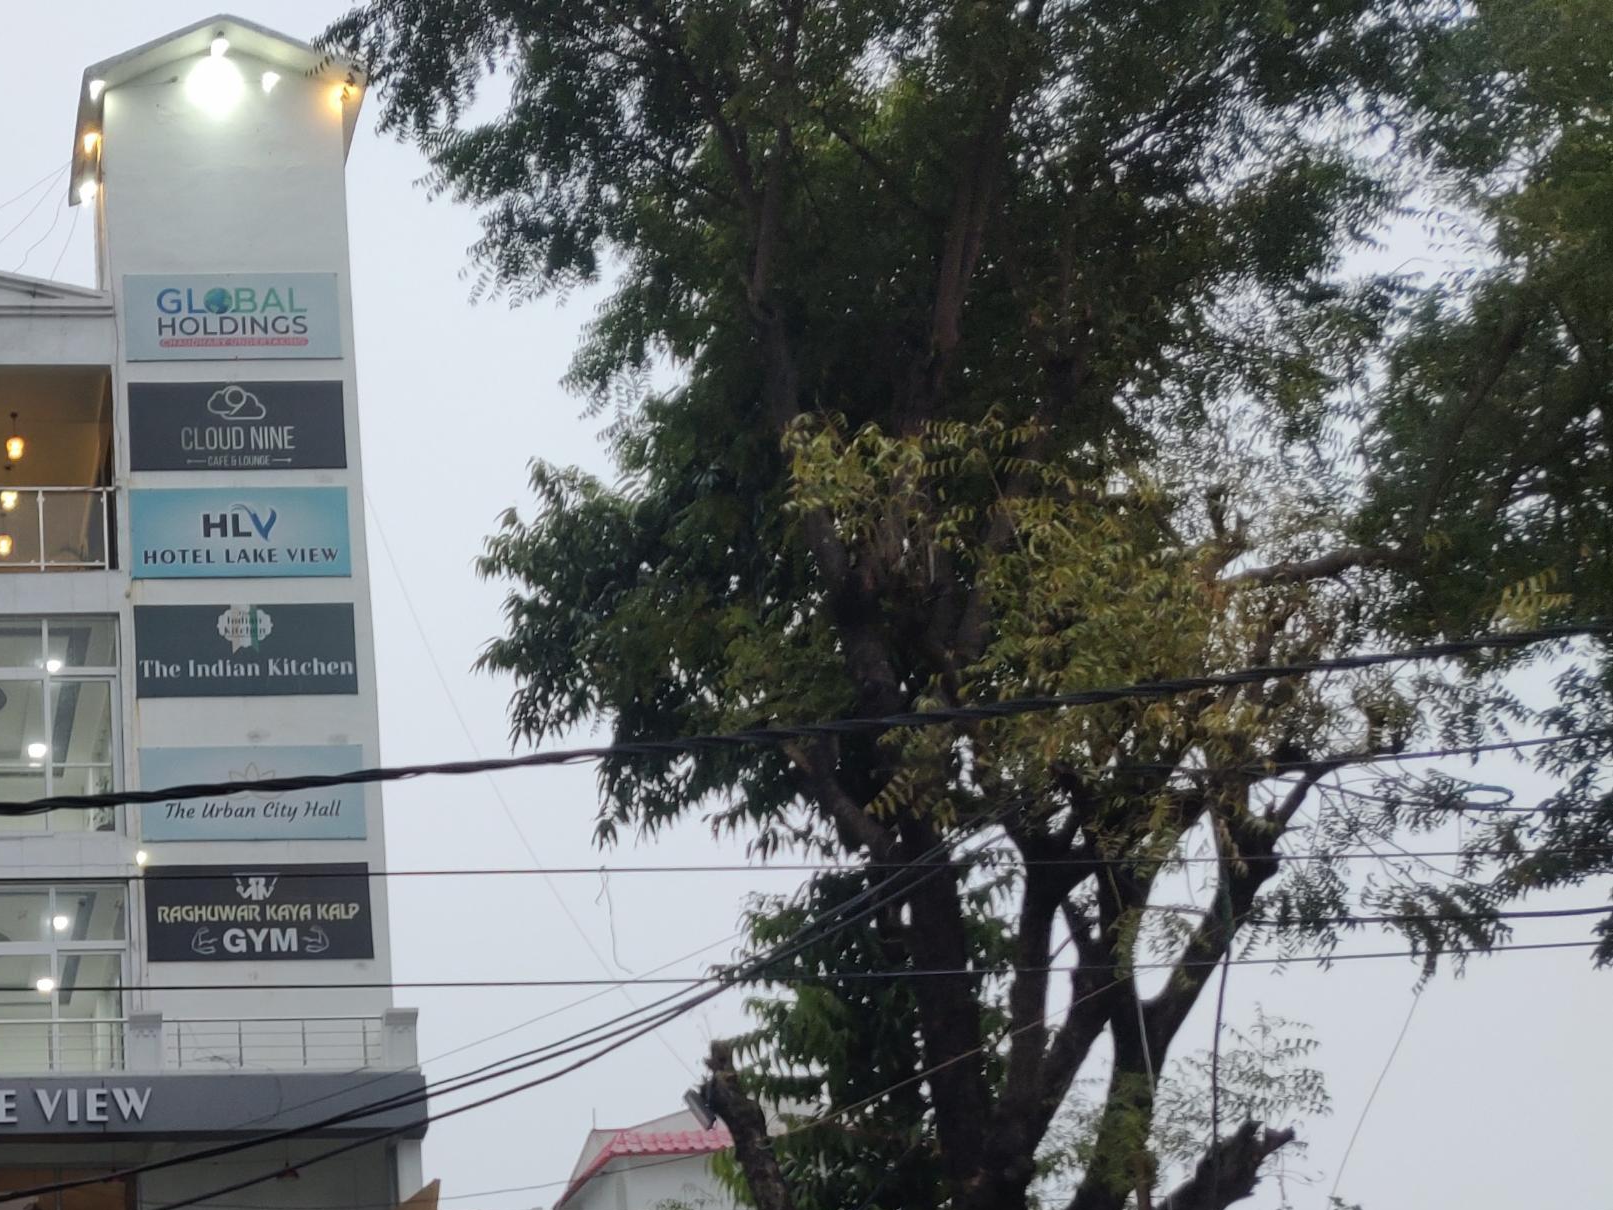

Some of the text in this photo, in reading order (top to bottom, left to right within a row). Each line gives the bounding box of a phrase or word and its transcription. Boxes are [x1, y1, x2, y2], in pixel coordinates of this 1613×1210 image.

[156, 287, 308, 314] GLOBAL
[157, 315, 308, 336] HOLDINGS
[181, 425, 296, 450] CLOUD NINE
[239, 455, 271, 466] LOUNGE
[203, 504, 277, 541] HLV
[143, 548, 339, 564] HOTEL LAKE VIEW
[140, 657, 354, 679] The Indian Kitchen
[165, 800, 341, 822] The Urban City Hall
[157, 903, 360, 923] RAGHUWAR KAYA KALP
[223, 928, 298, 952] GYM
[34, 1087, 152, 1123] VIEW
